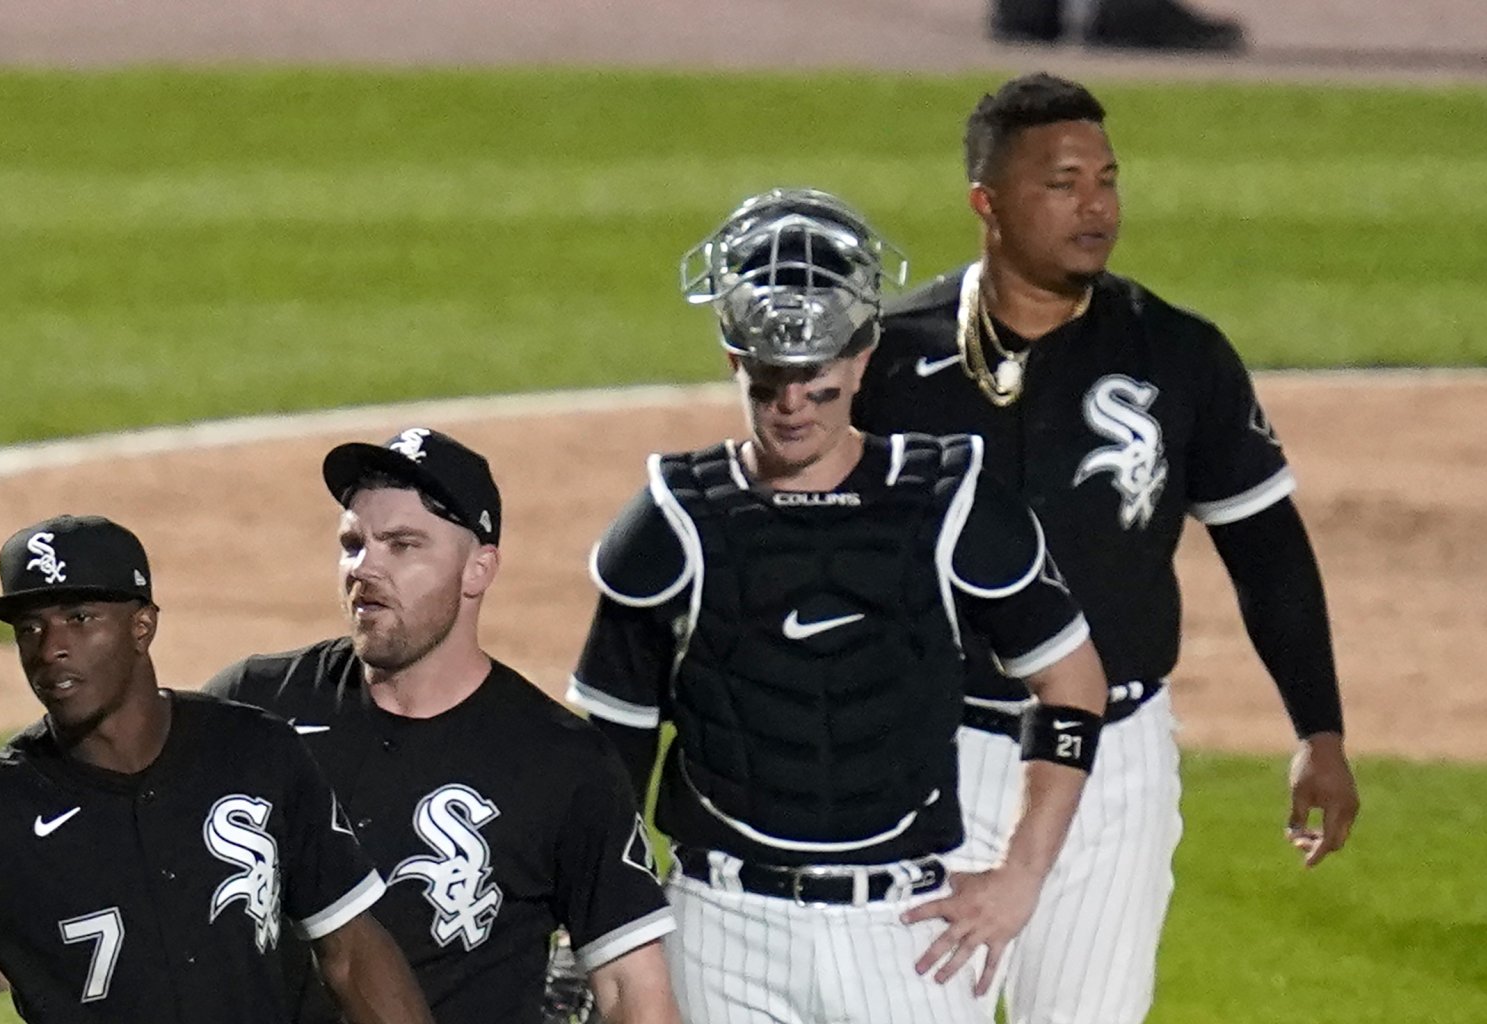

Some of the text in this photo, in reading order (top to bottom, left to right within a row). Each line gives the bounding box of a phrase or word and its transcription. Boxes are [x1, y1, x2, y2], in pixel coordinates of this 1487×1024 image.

[773, 492, 861, 506] COLLINS
[1072, 373, 1169, 530] Sox
[26, 532, 66, 584] Sox
[1056, 734, 1082, 759] 21
[203, 794, 280, 954] Sox
[387, 783, 503, 952] Sox
[58, 907, 126, 1003] 7
